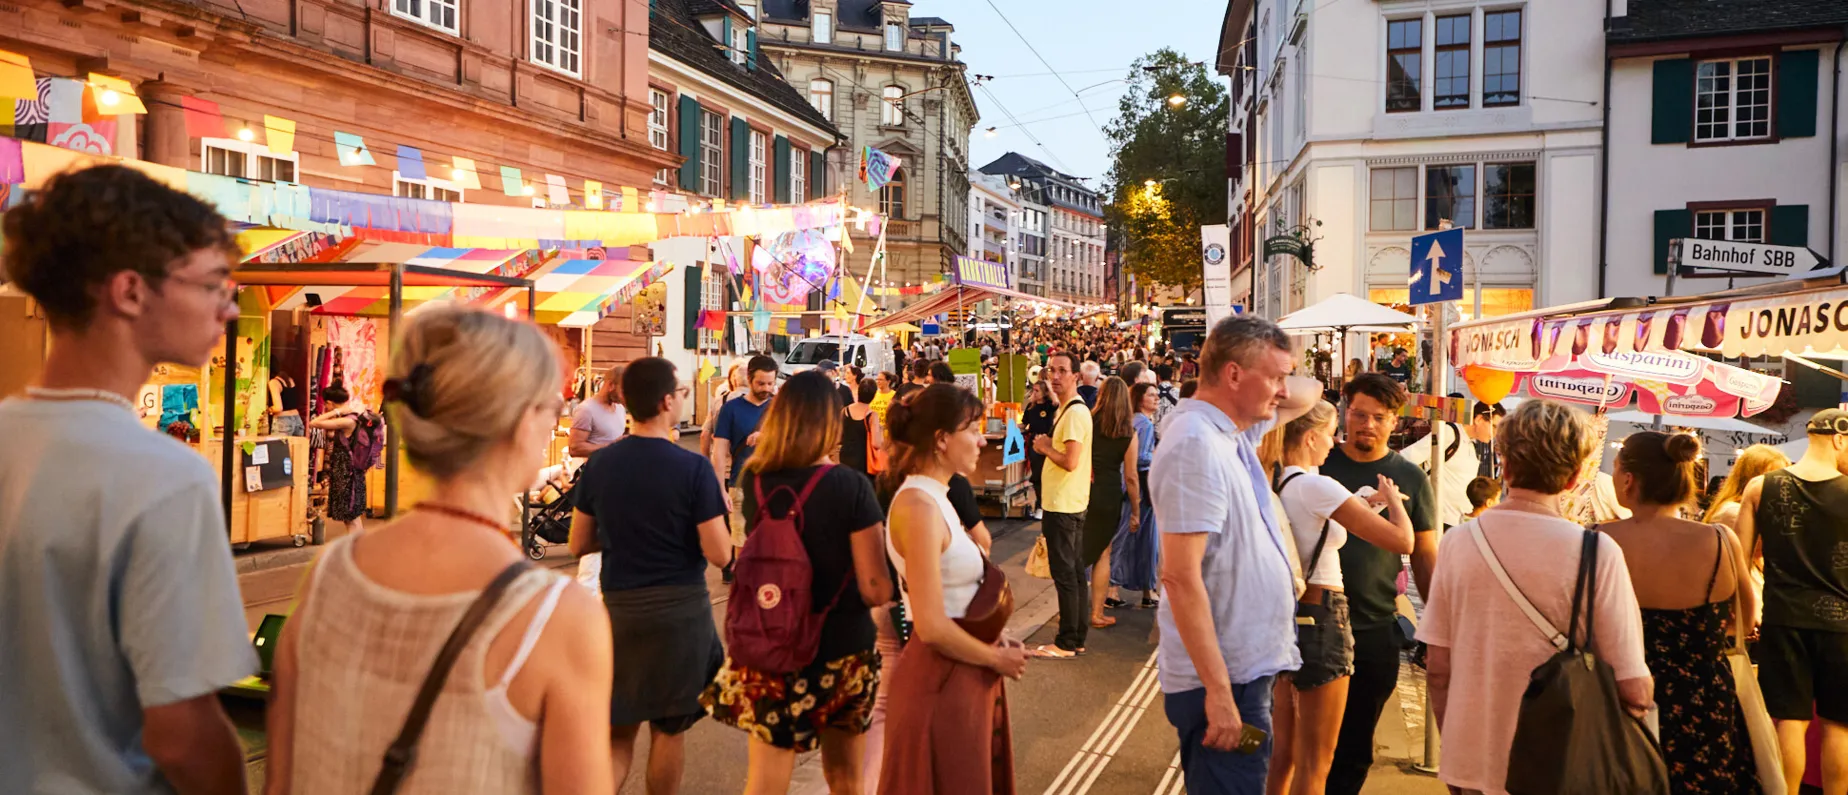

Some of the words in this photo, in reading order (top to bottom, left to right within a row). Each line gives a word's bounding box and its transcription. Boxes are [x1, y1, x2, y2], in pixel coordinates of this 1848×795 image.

[1692, 243, 1756, 265] Bahnhof
[1763, 249, 1795, 268] SBB
[957, 256, 1007, 288] MARKTHALLE
[1599, 350, 1692, 370] asparini
